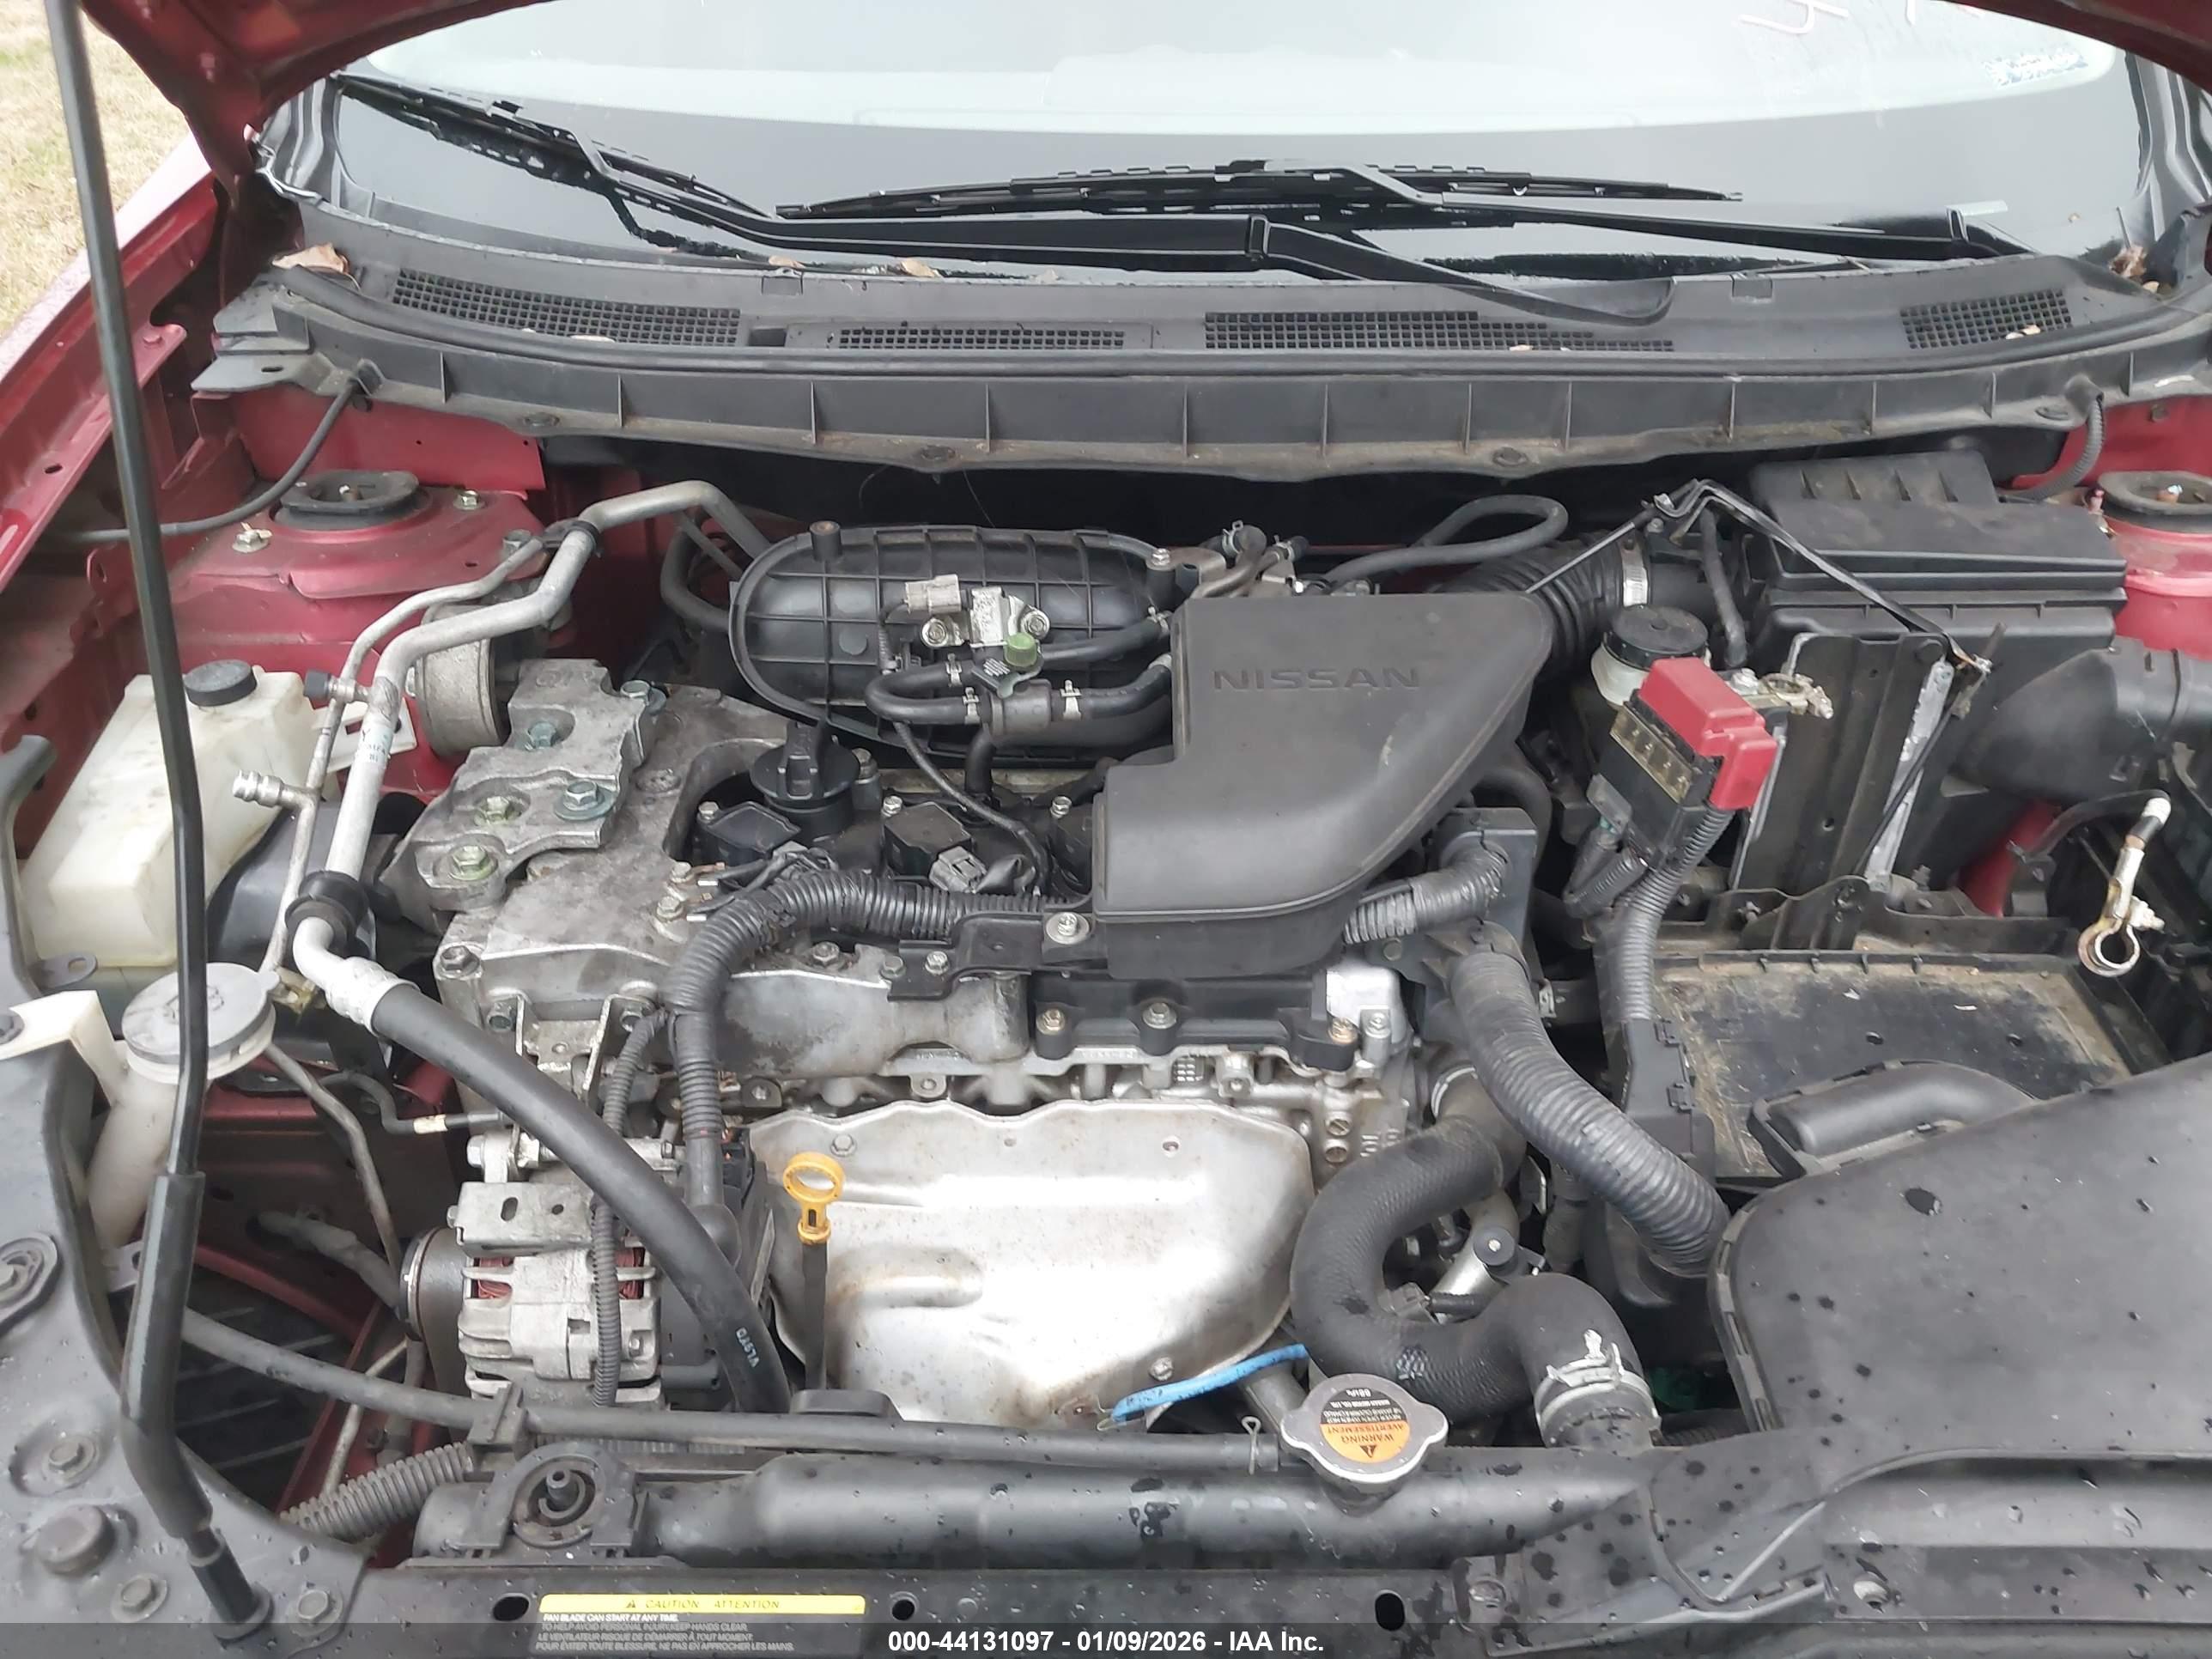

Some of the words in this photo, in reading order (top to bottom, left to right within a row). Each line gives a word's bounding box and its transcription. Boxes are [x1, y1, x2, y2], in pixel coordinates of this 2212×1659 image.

[1211, 667, 1421, 690] NISSAN
[1327, 1424, 1404, 1434] AVERTISSEMENT
[1340, 1434, 1395, 1443] WARNING
[646, 1600, 700, 1609] CAUTION
[714, 1600, 780, 1609] ATTENTION
[543, 1613, 560, 1622] FAN
[560, 1613, 586, 1622] BLADE
[586, 1613, 605, 1622] CAN
[605, 1613, 630, 1622] START
[630, 1613, 641, 1622] AT
[641, 1613, 659, 1622] ANY
[542, 1623, 552, 1632] TO
[553, 1623, 574, 1632] HELP
[574, 1623, 599, 1632] AVOID
[600, 1623, 642, 1632] PERSONAL
[691, 1623, 720, 1632] HANDS
[659, 1642, 672, 1650] NE
[672, 1642, 688, 1650] PAS
[750, 1642, 767, 1650] LES
